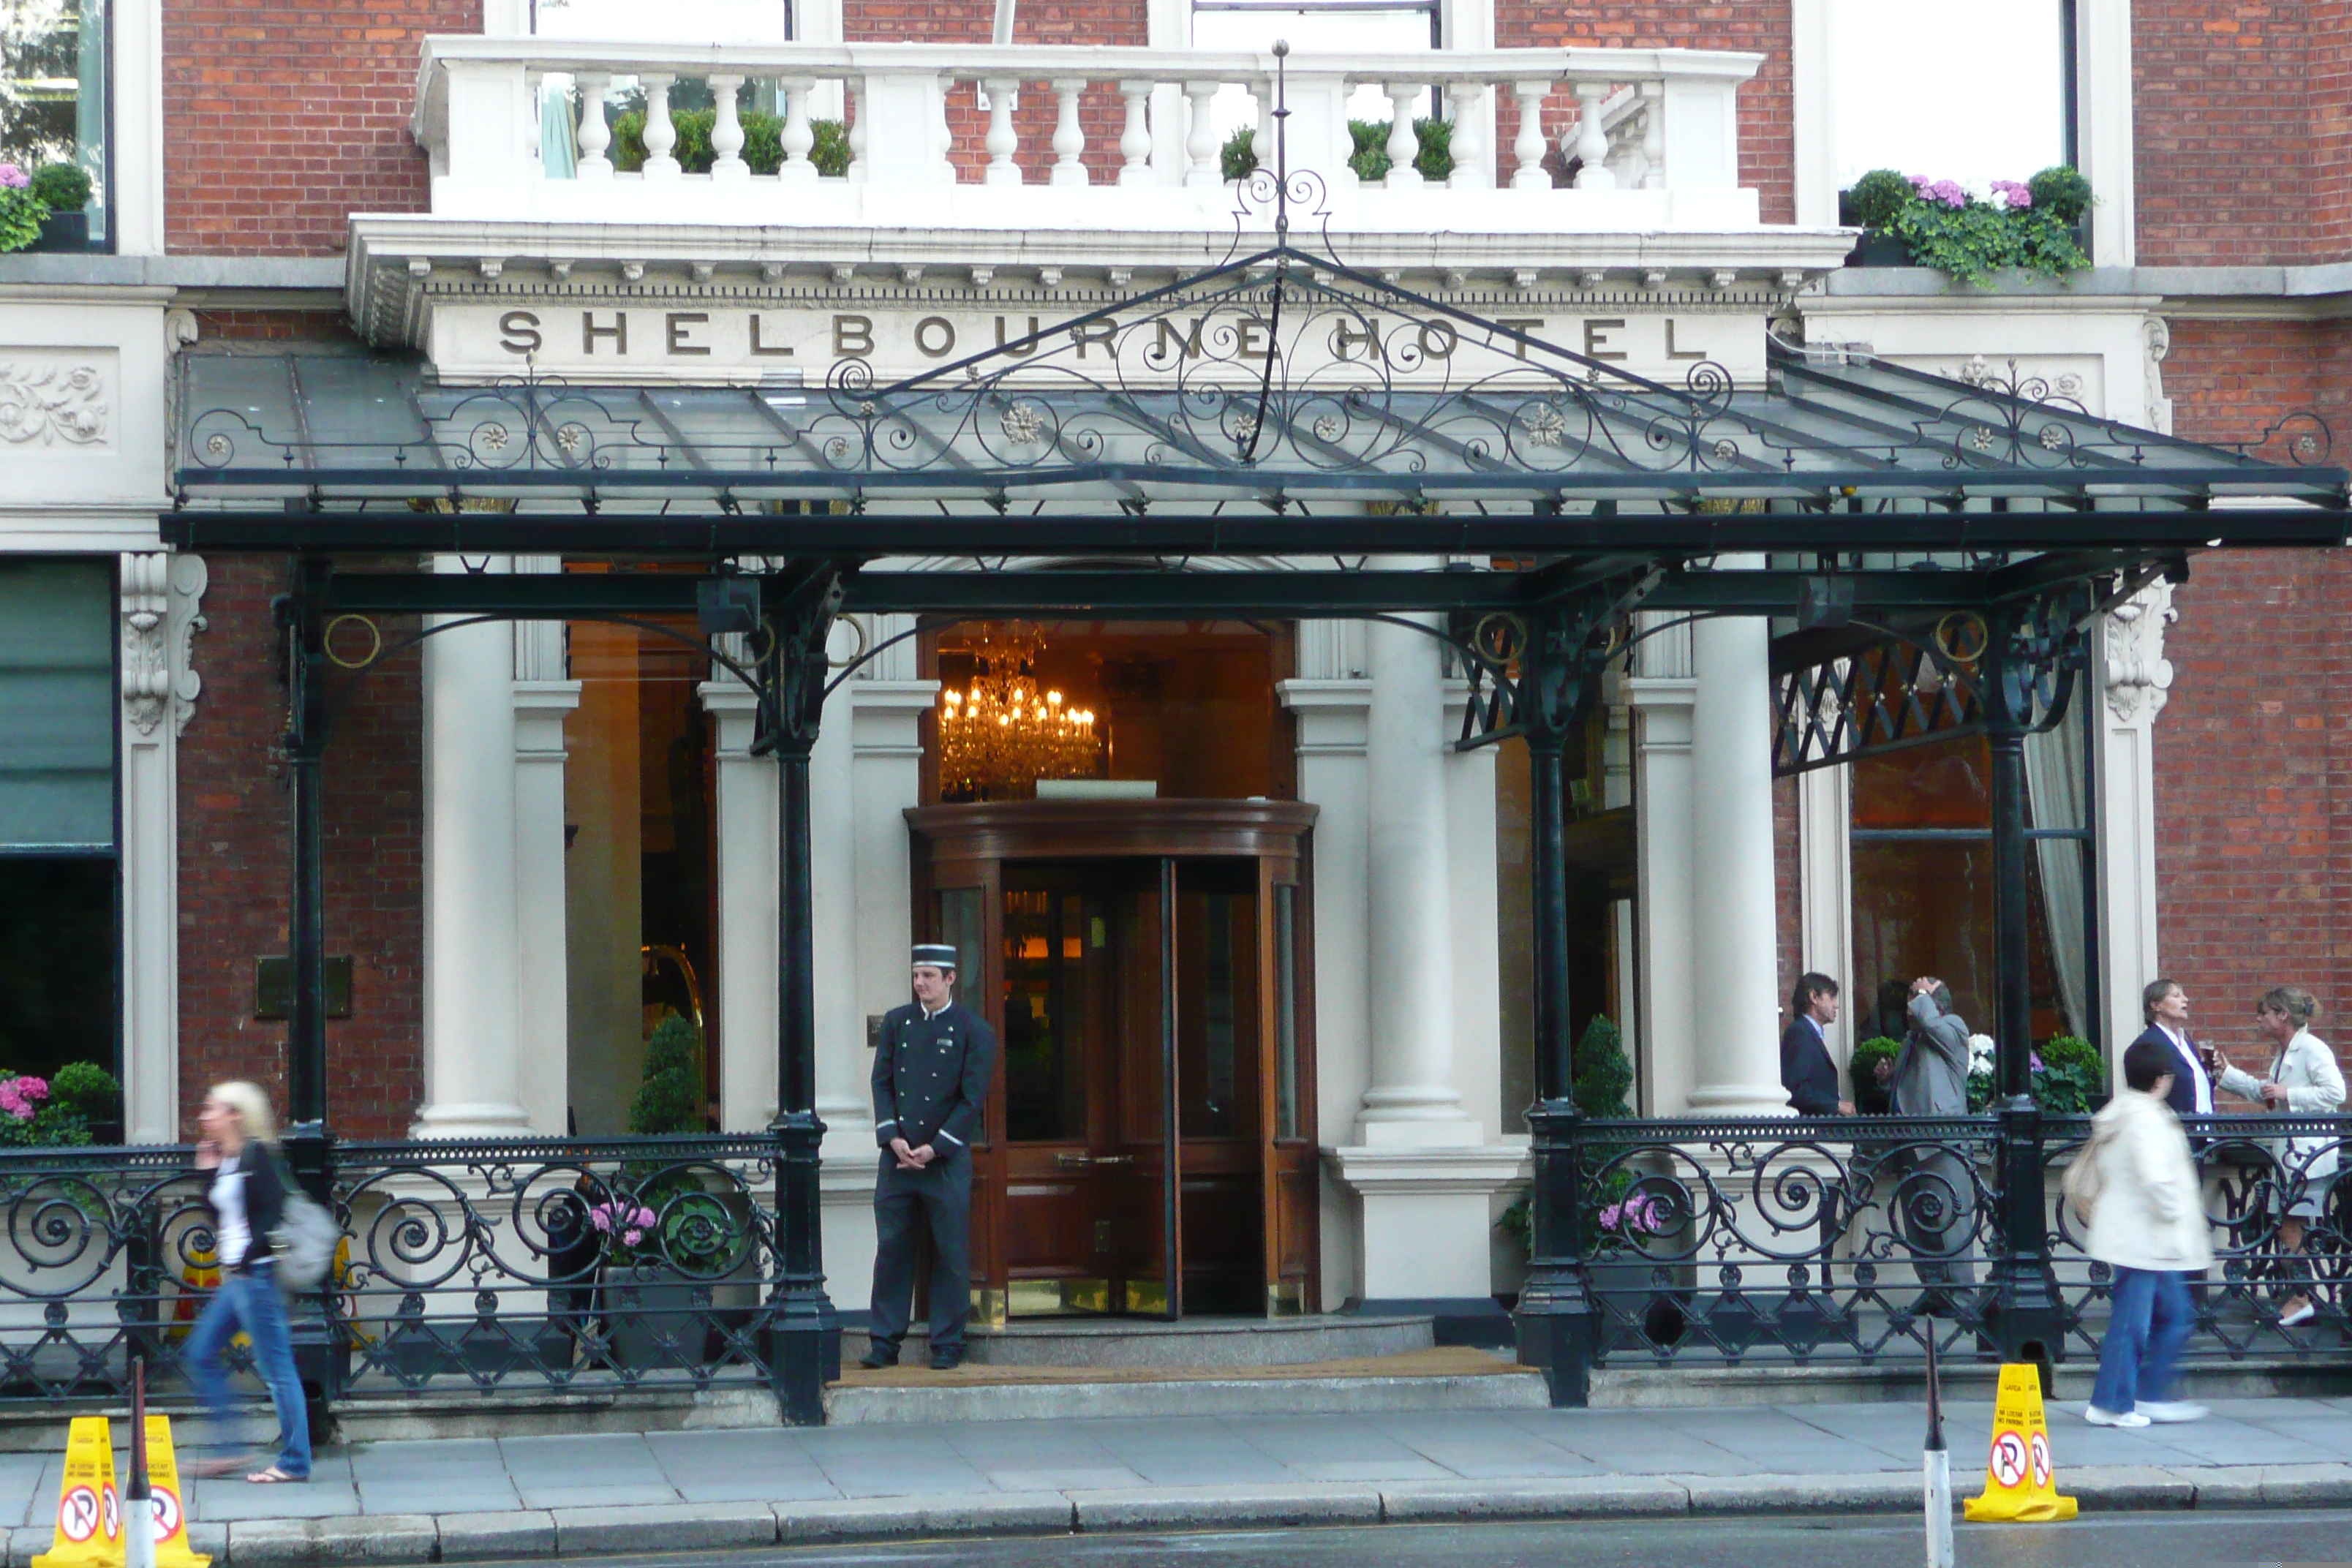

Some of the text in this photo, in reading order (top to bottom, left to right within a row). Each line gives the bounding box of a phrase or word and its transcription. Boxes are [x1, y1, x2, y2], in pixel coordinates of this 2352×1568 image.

[499, 310, 1707, 360] SHELBOURNE HOTEL
[2006, 1418, 2024, 1426] PARKING
